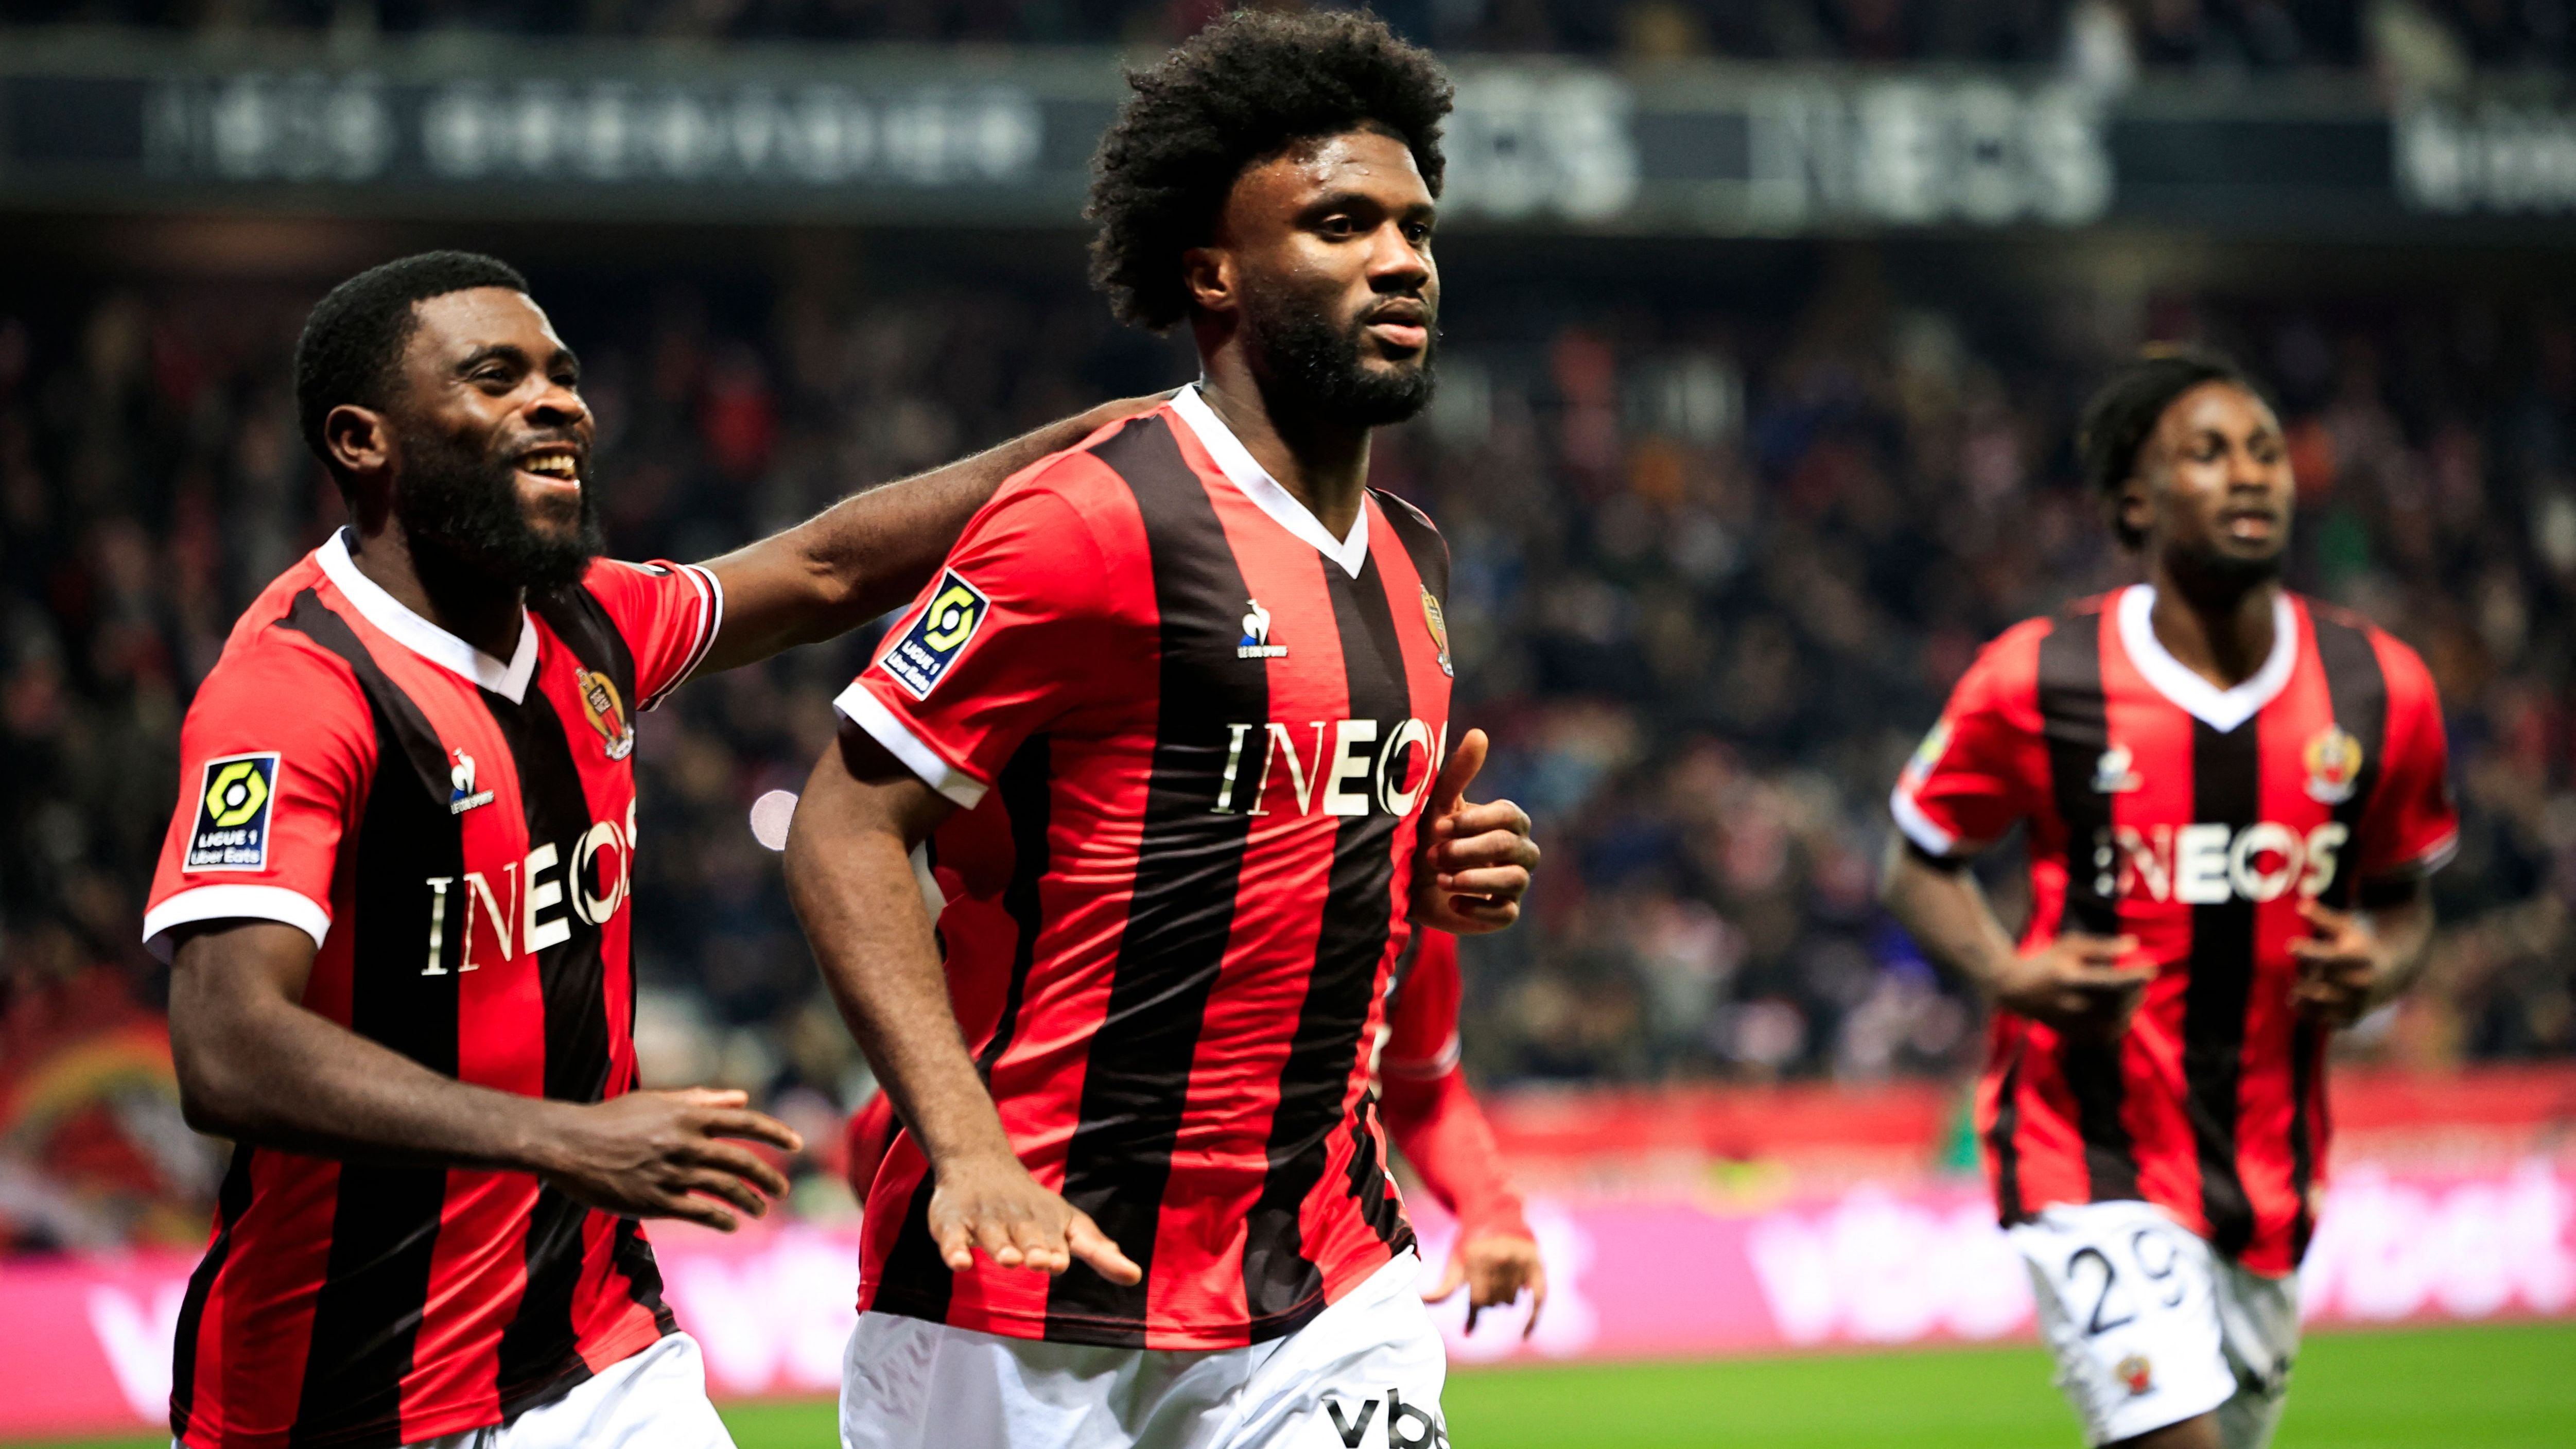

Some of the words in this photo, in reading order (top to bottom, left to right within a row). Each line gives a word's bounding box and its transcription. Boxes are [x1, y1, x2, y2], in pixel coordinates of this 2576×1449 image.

[901, 639, 934, 670] LIGUE
[930, 663, 941, 675] 1
[190, 849, 223, 865] Uber
[223, 846, 260, 864] Eats
[198, 829, 247, 848] LIGUE
[248, 829, 258, 845] 1
[2092, 821, 2349, 904] INEOS
[2066, 1229, 2185, 1339] 29
